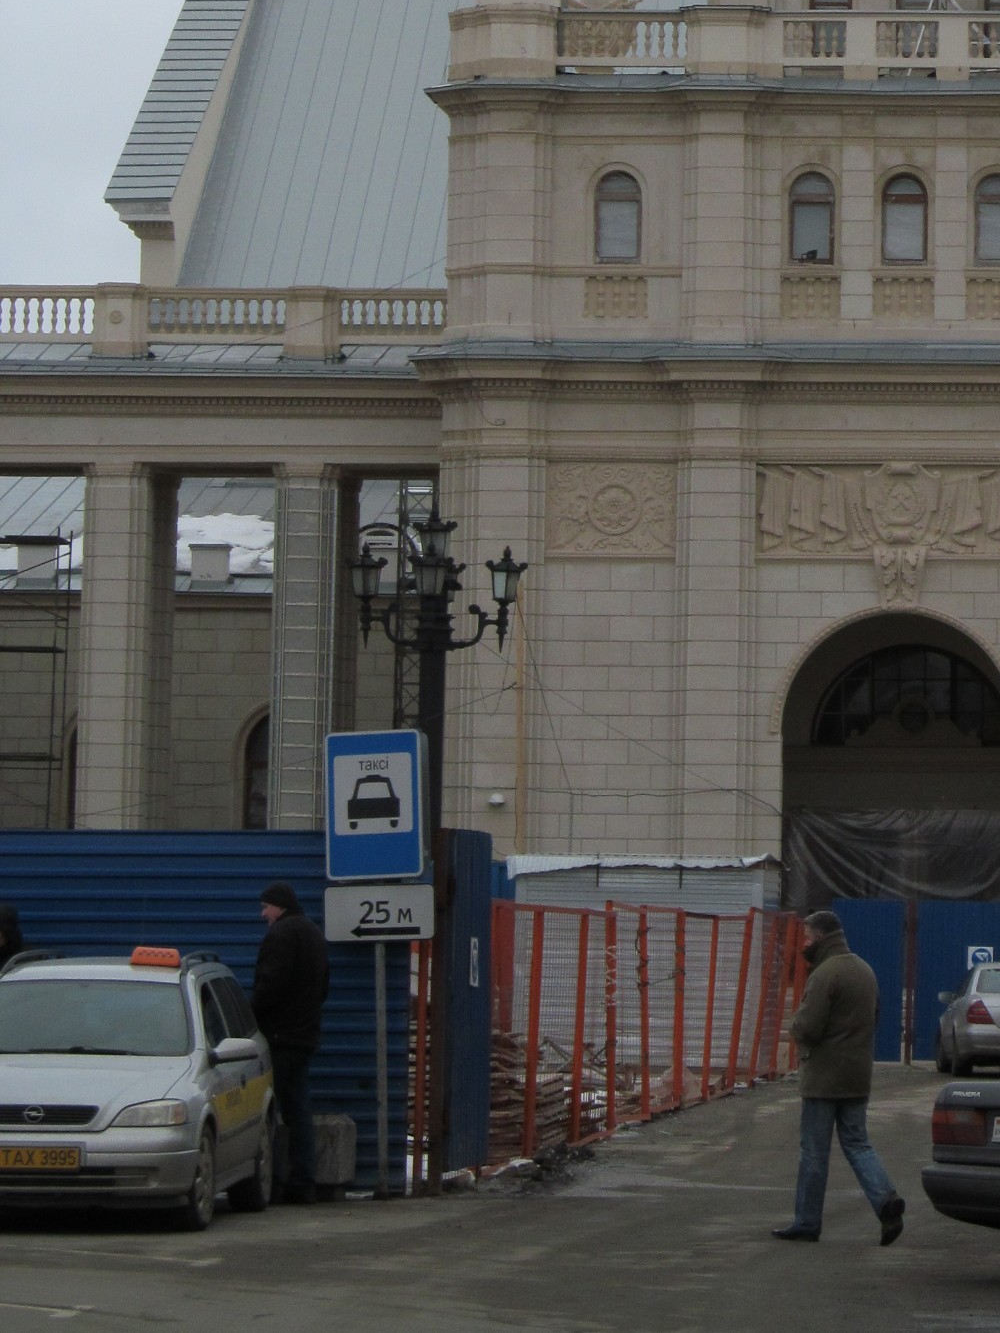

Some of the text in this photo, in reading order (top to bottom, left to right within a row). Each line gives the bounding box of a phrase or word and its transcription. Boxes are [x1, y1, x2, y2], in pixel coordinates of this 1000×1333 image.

[359, 756, 389, 771] таксі
[359, 900, 390, 925] 25
[2, 1149, 77, 1166] TAX 3995
